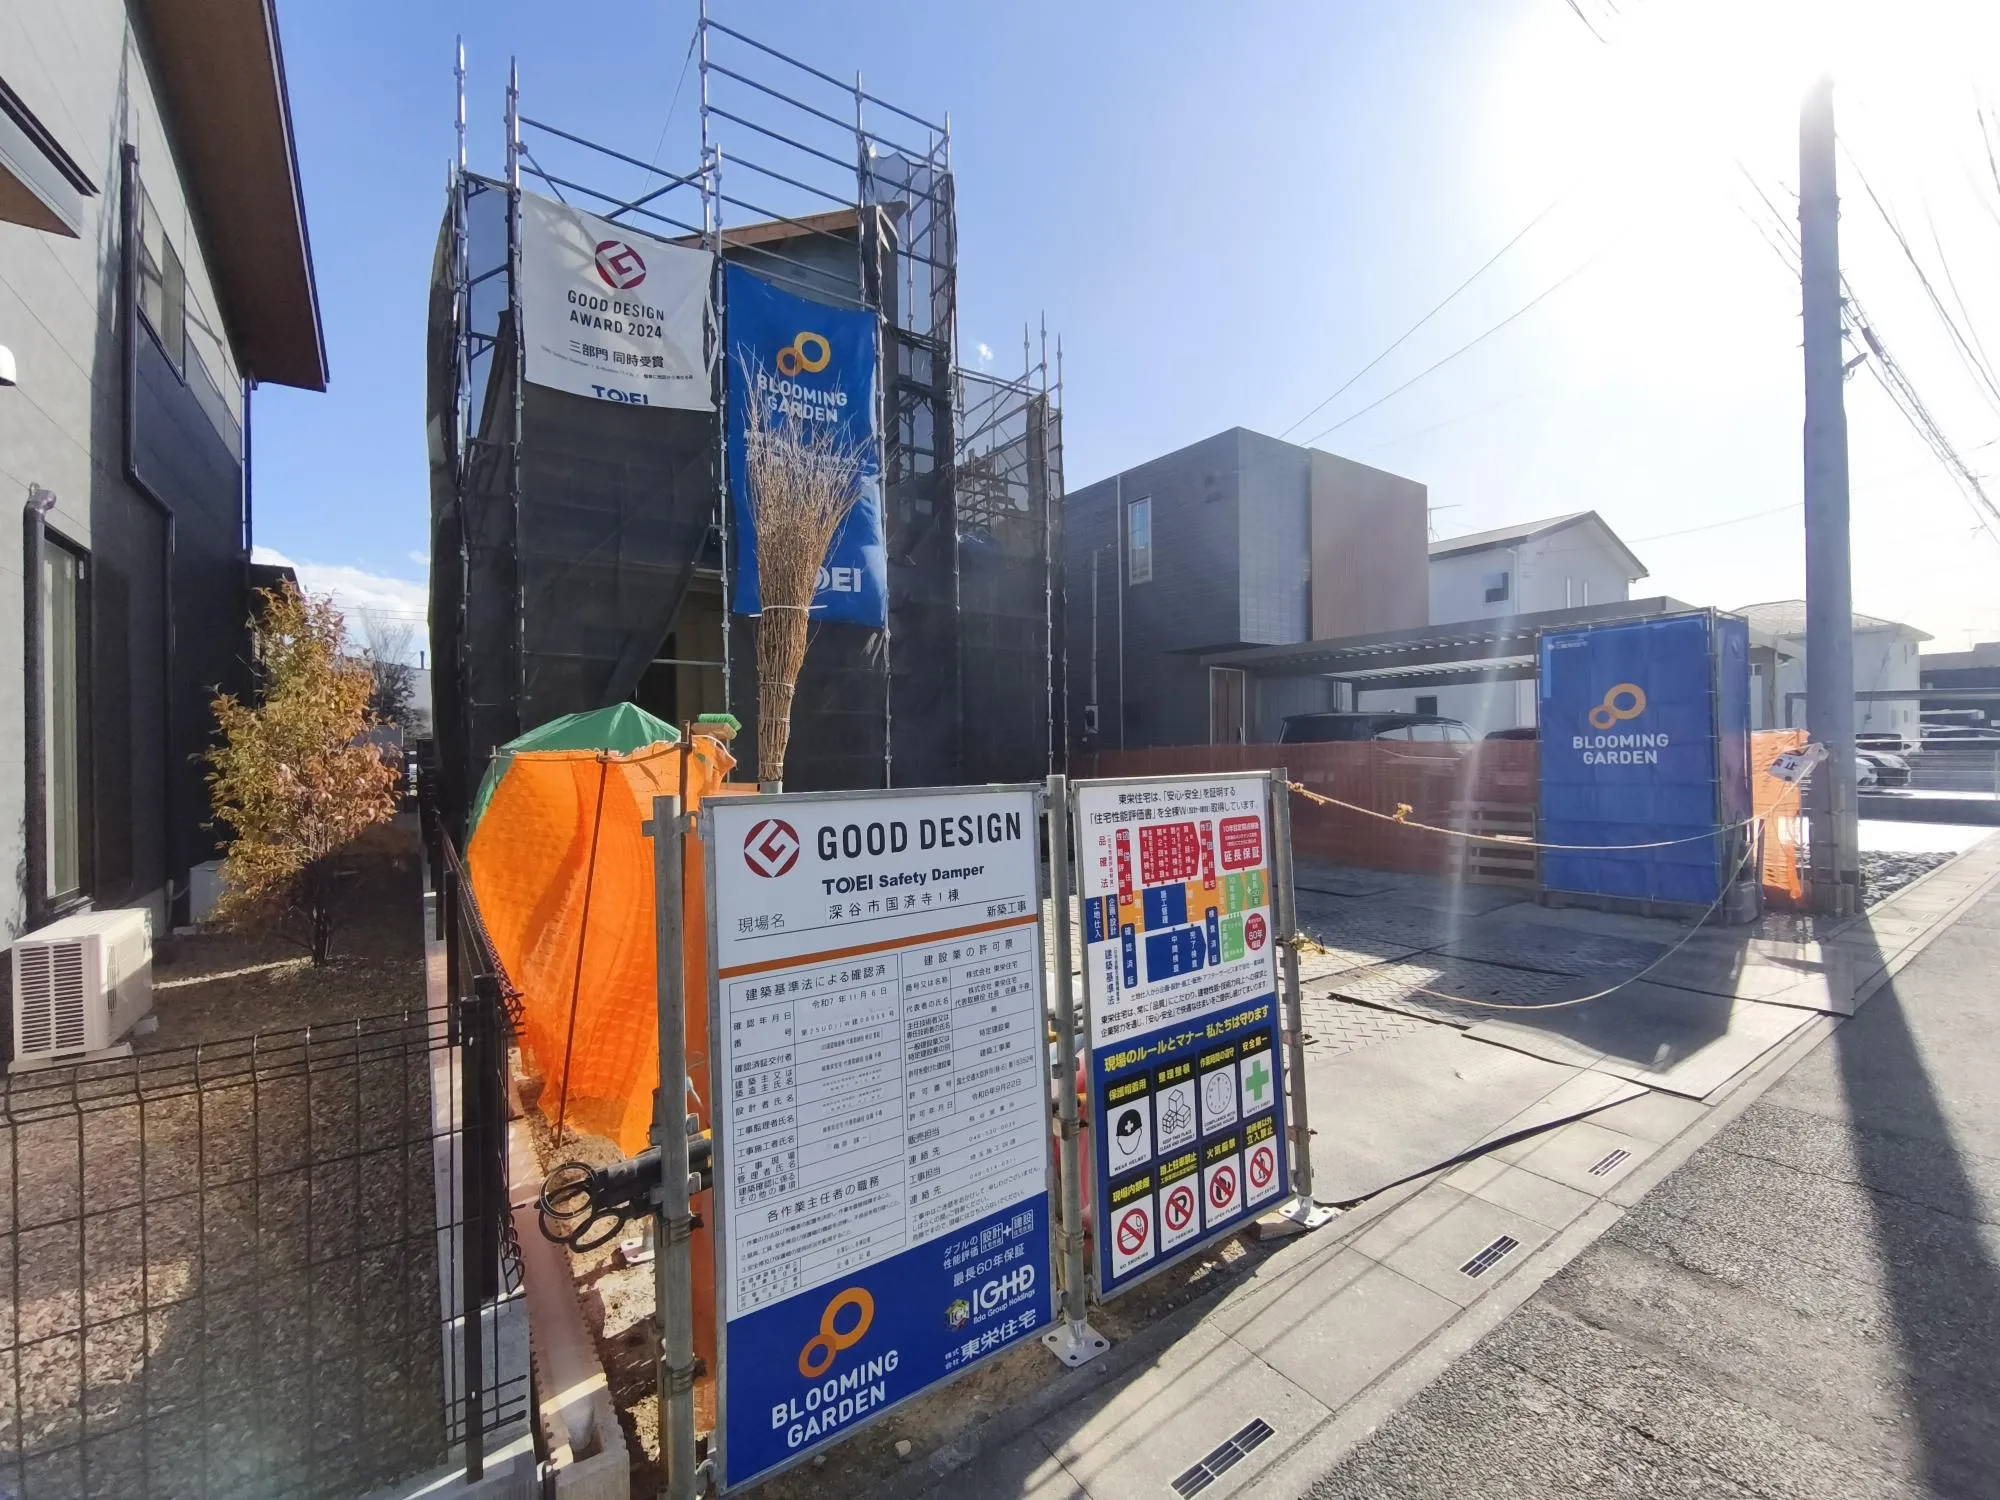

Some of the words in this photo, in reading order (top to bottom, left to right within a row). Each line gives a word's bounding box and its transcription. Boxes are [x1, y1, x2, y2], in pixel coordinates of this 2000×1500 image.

[568, 290, 608, 312] GOOD
[613, 301, 664, 321] DESIGN
[570, 310, 622, 333] AWARD
[628, 323, 662, 338] 2024
[569, 340, 609, 361] 三部門
[613, 351, 664, 369] 同時受賞
[757, 374, 847, 406] BLOOMING
[768, 396, 837, 422] GARDEN
[1572, 734, 1669, 749] BLOOMING
[1583, 750, 1657, 765] GARDEN
[817, 820, 908, 861] GOOD
[920, 811, 1020, 850] DESIGN
[1098, 835, 1108, 888] 品確法
[1223, 846, 1260, 862] 延長保証
[822, 874, 872, 895] TOEI
[878, 870, 927, 890] Safety
[931, 863, 984, 882] Damper
[986, 900, 1026, 917] 新築工事
[1093, 902, 1101, 937] 土地仕入
[737, 912, 784, 934] 現場名
[924, 938, 1012, 966] 建設業の許可票
[745, 964, 885, 1001] 建築基準法による確認済
[905, 976, 948, 992] 商号又は名称
[906, 996, 948, 1013] 代表者の氏名
[733, 1010, 791, 1031] 確認年月日
[1104, 1026, 1203, 1072] 現場のルールとマナー
[1206, 1004, 1269, 1038] 私たちは守ります
[735, 1093, 793, 1117] 設計者氏名
[907, 1126, 939, 1145] 販売担当
[908, 1145, 940, 1165] 連絡先
[909, 1165, 940, 1185] 工事担当
[767, 1174, 879, 1224] 各作業主任者の職務
[909, 1184, 941, 1205] 連絡先
[944, 1235, 978, 1258] ダブルの
[982, 1226, 1000, 1244] 設計
[1013, 1212, 1031, 1229] 建設
[943, 1245, 978, 1270] 性能評価
[953, 1242, 1024, 1287] 最長60年保証
[987, 1301, 1007, 1318] Group
[1009, 1287, 1034, 1307] Holdings
[960, 1306, 1036, 1362] 東栄住宅
[772, 1349, 899, 1429] BLOOMING
[787, 1381, 886, 1448] GARDEN
